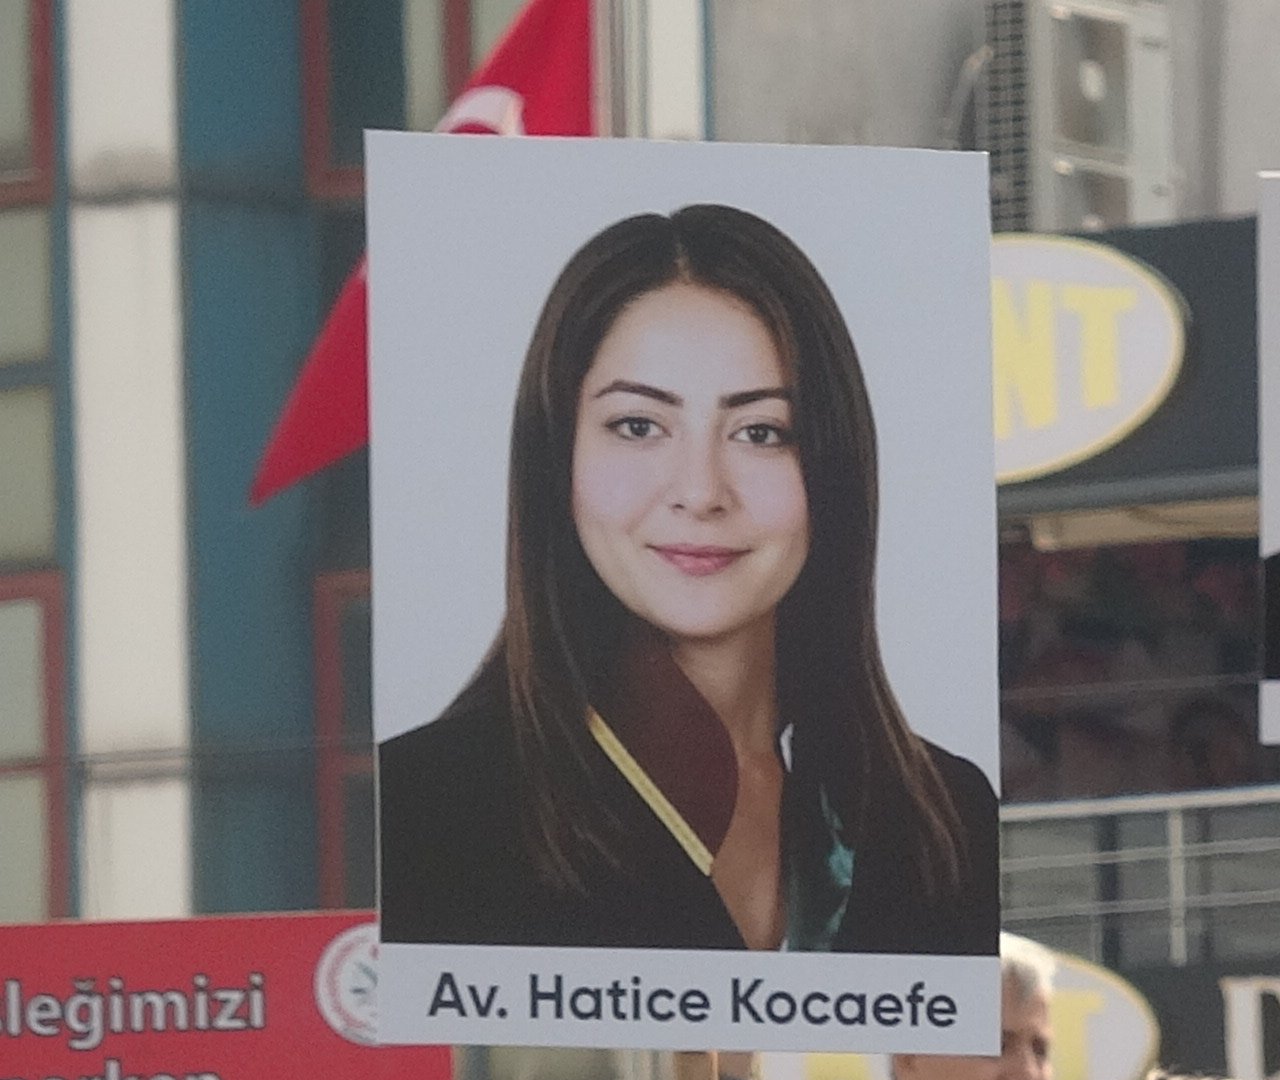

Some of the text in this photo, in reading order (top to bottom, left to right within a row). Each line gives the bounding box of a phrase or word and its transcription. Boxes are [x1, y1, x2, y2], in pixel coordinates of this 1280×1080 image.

[0, 972, 266, 1050] leğimizi
[428, 971, 959, 1028] Av. Hatice Kocaefe
